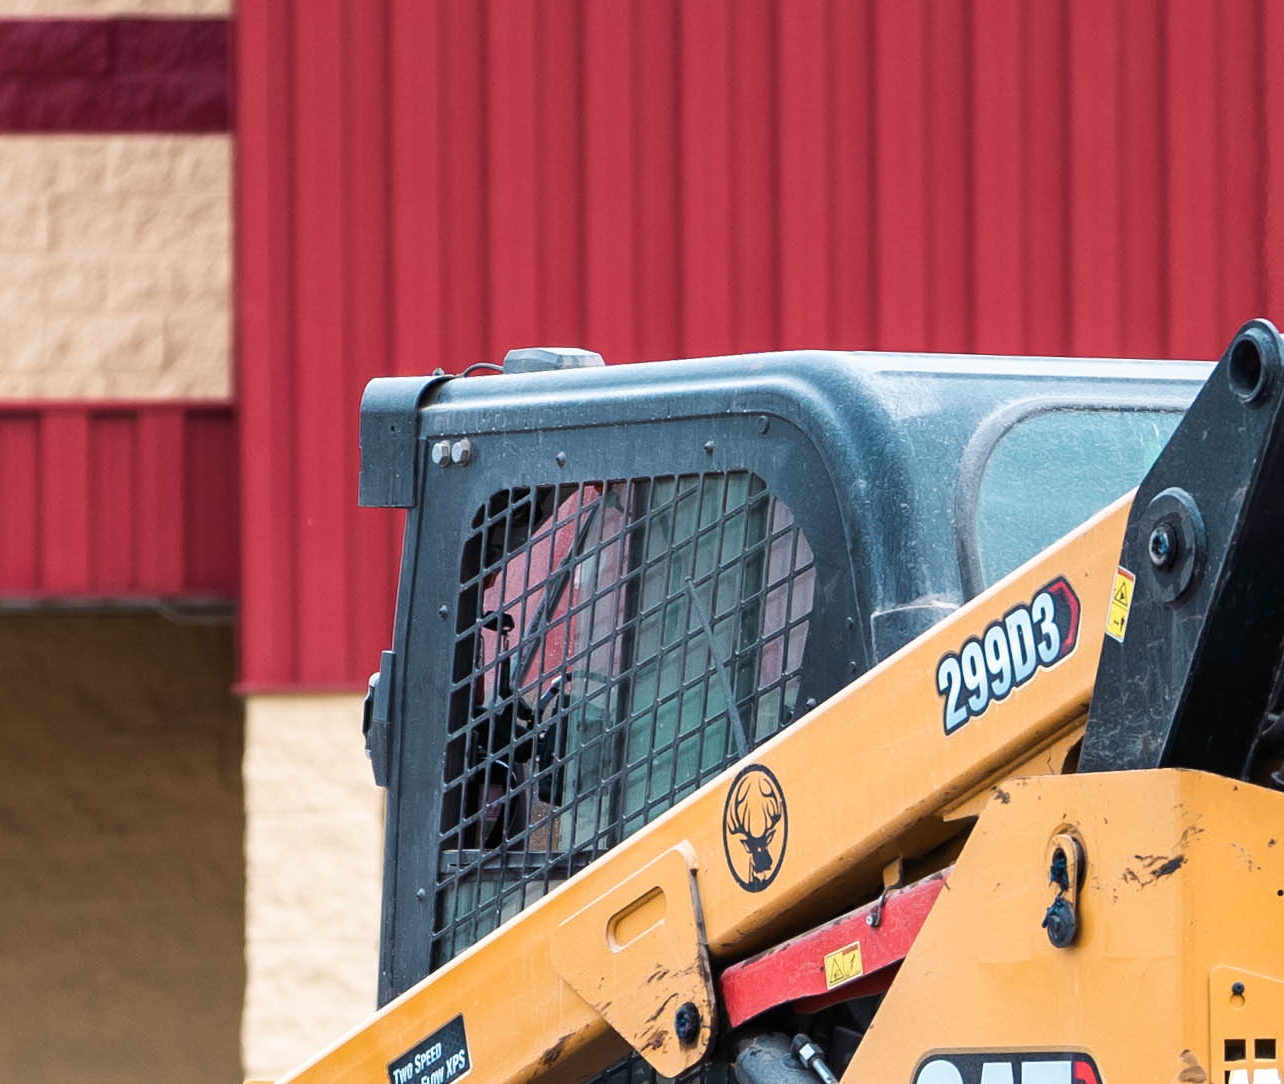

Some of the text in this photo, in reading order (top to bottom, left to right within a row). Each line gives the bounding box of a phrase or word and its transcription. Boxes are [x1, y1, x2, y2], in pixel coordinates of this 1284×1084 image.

[937, 591, 1062, 732] 299D3
[414, 1042, 442, 1074] SPEED
[446, 1049, 466, 1079] XPS
